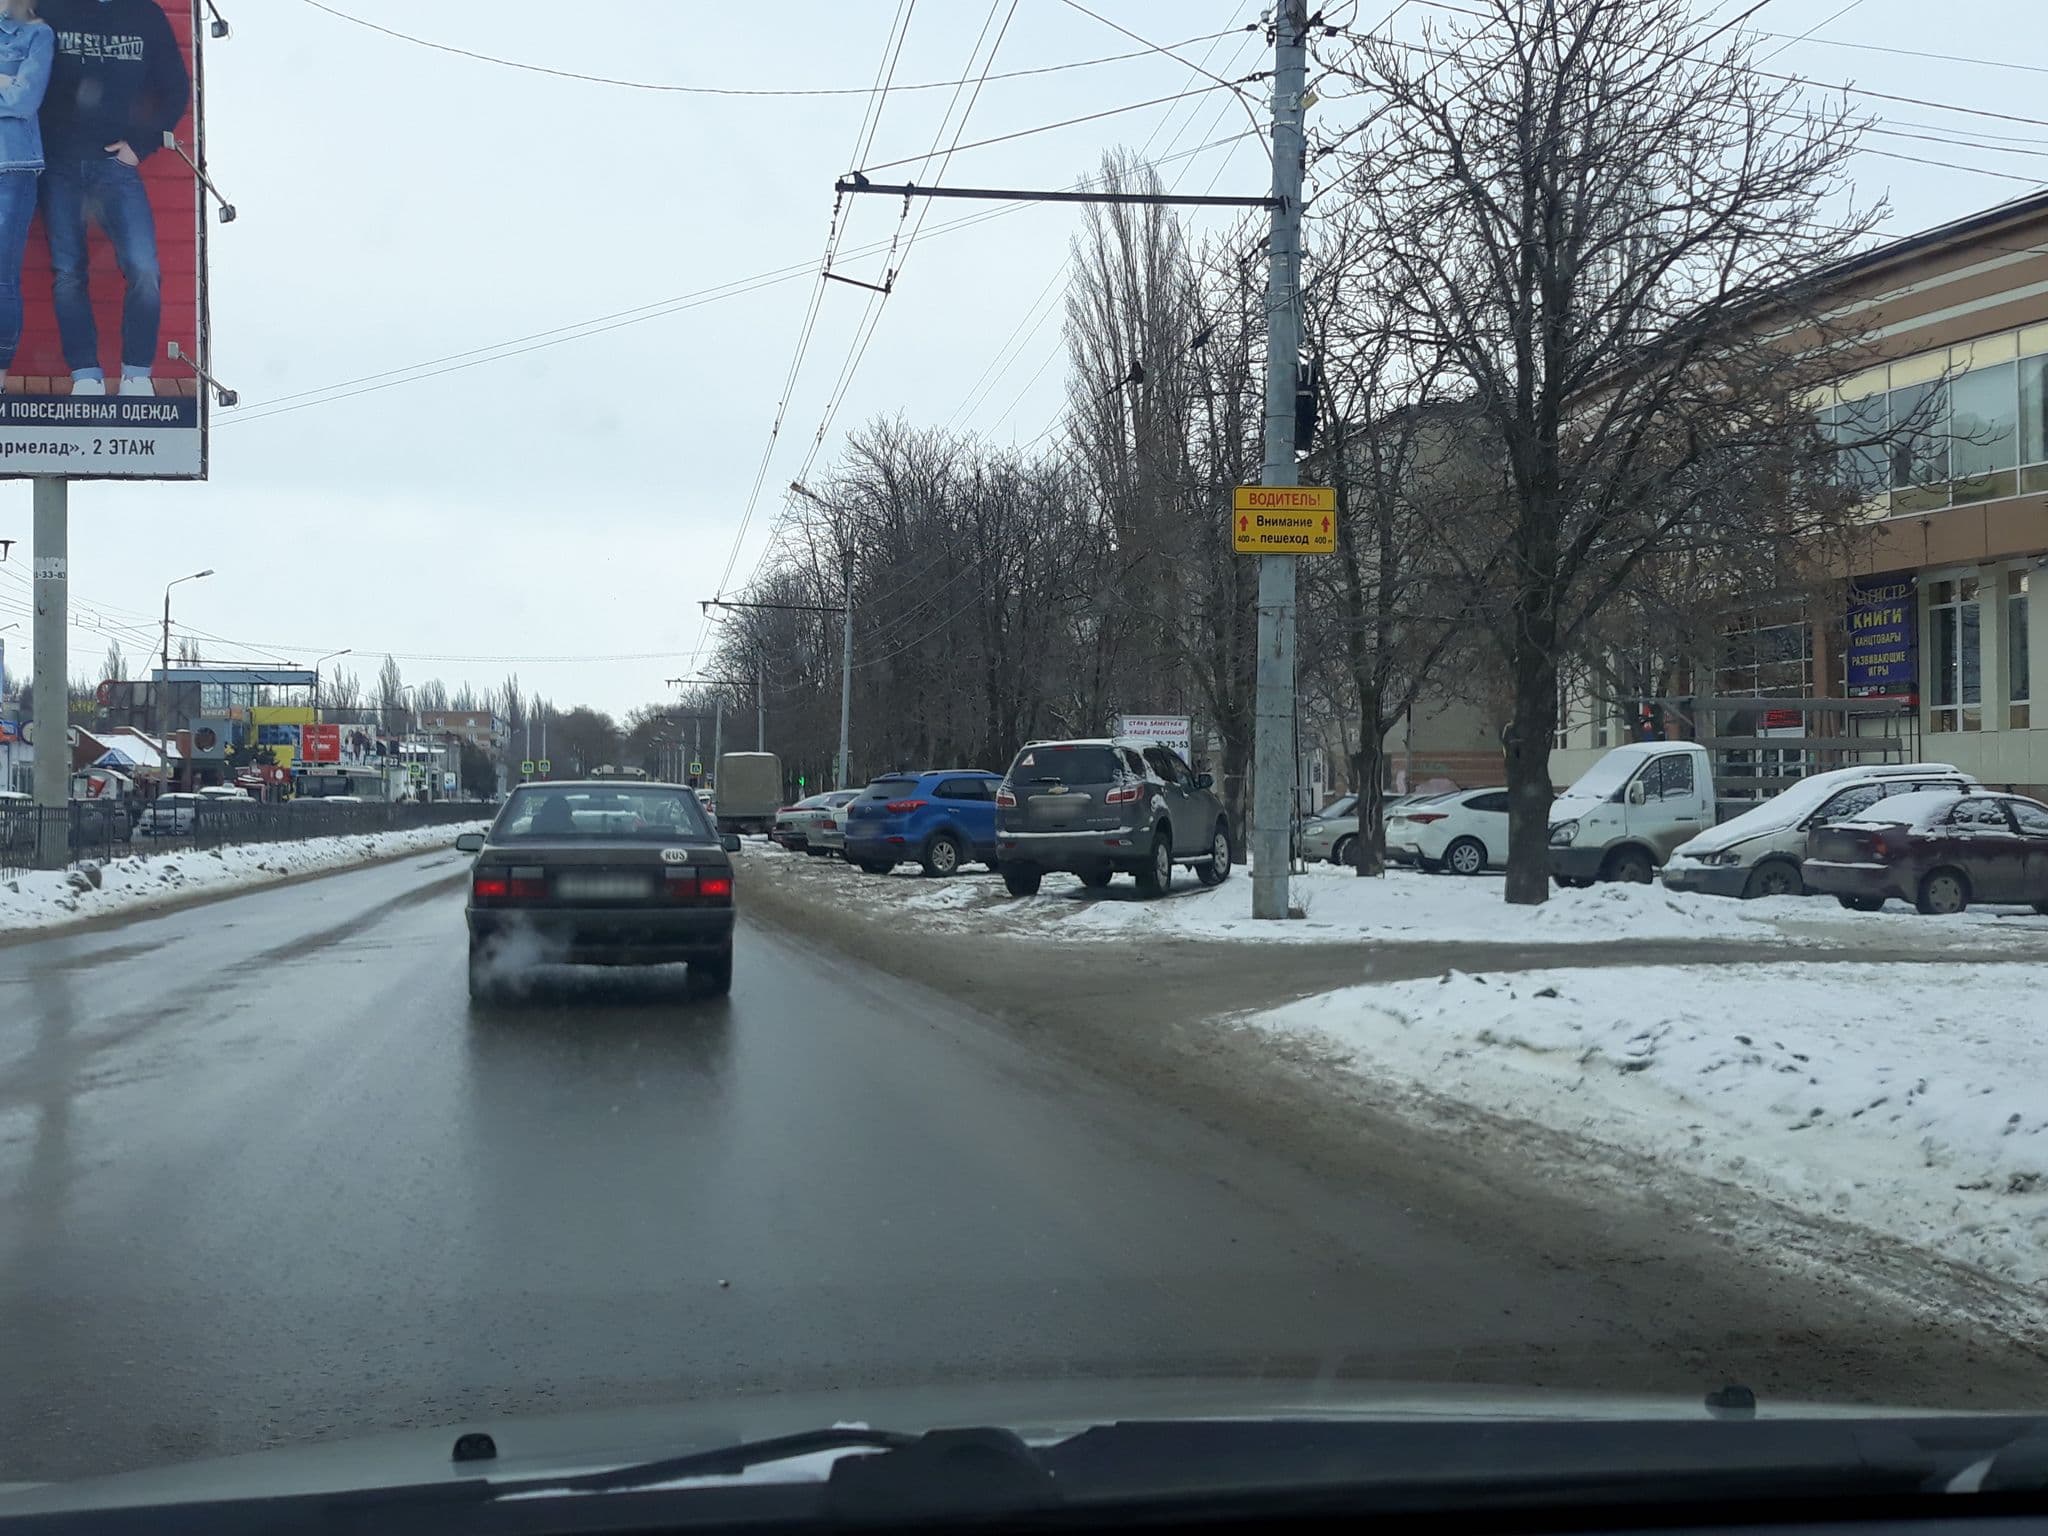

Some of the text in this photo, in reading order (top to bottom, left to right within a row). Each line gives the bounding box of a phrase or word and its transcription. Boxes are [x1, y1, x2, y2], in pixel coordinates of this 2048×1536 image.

[11, 402, 117, 420] ПОВСЕДНЕВНАЯ
[121, 404, 179, 421] ОДЕЖДА
[92, 439, 102, 455] 2
[109, 439, 156, 456] ЭТАЖ
[1249, 492, 1320, 507] ВОДИТЕЛЬ!
[1256, 515, 1313, 528] Внимание
[1260, 534, 1309, 545] пешеход
[1853, 608, 1902, 629] КНИГИ
[1855, 632, 1901, 648] КАНЦТОВАРЫ
[1852, 651, 1906, 666] РАЗВИВАЮЩИЕ
[1868, 665, 1889, 677] ИГРЫ
[665, 850, 685, 861] RUS
